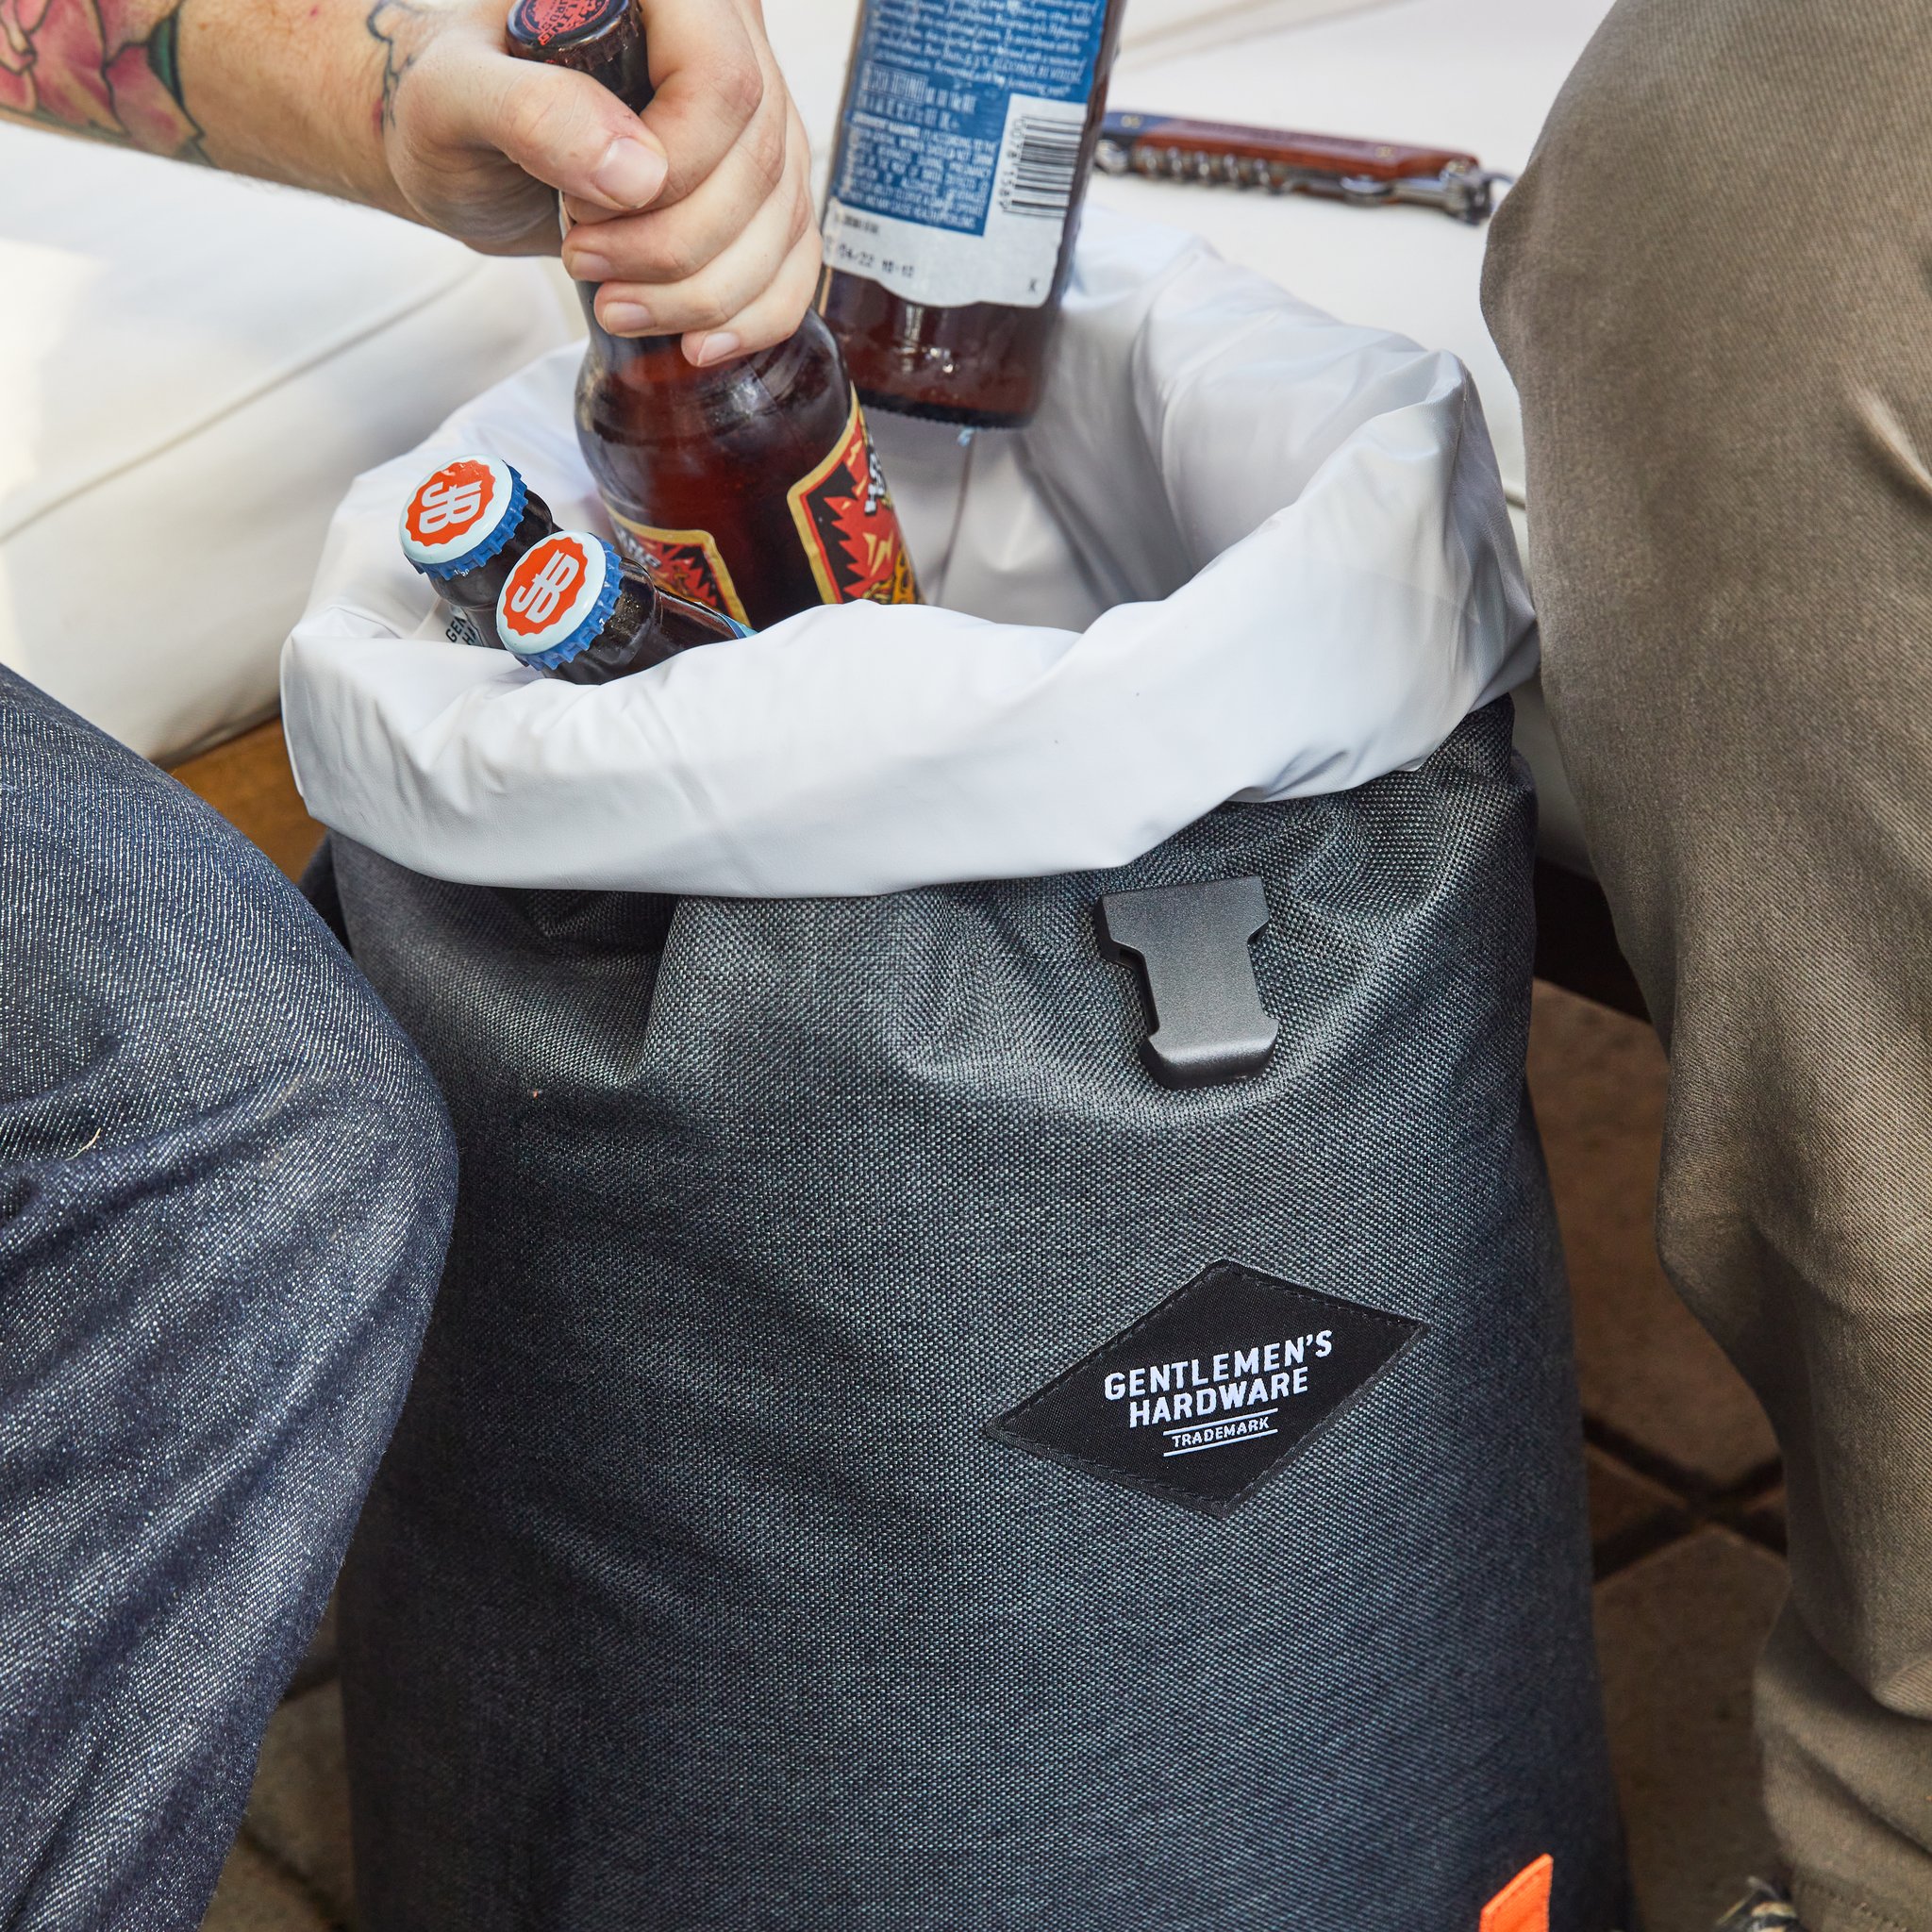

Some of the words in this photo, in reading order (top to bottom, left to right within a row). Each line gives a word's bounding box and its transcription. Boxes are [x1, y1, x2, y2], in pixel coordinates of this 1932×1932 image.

[1104, 1329, 1333, 1401] GENTLEMEN'S
[1129, 1366, 1308, 1428] HARDWARE
[1172, 1416, 1270, 1449] TRADEMARK
